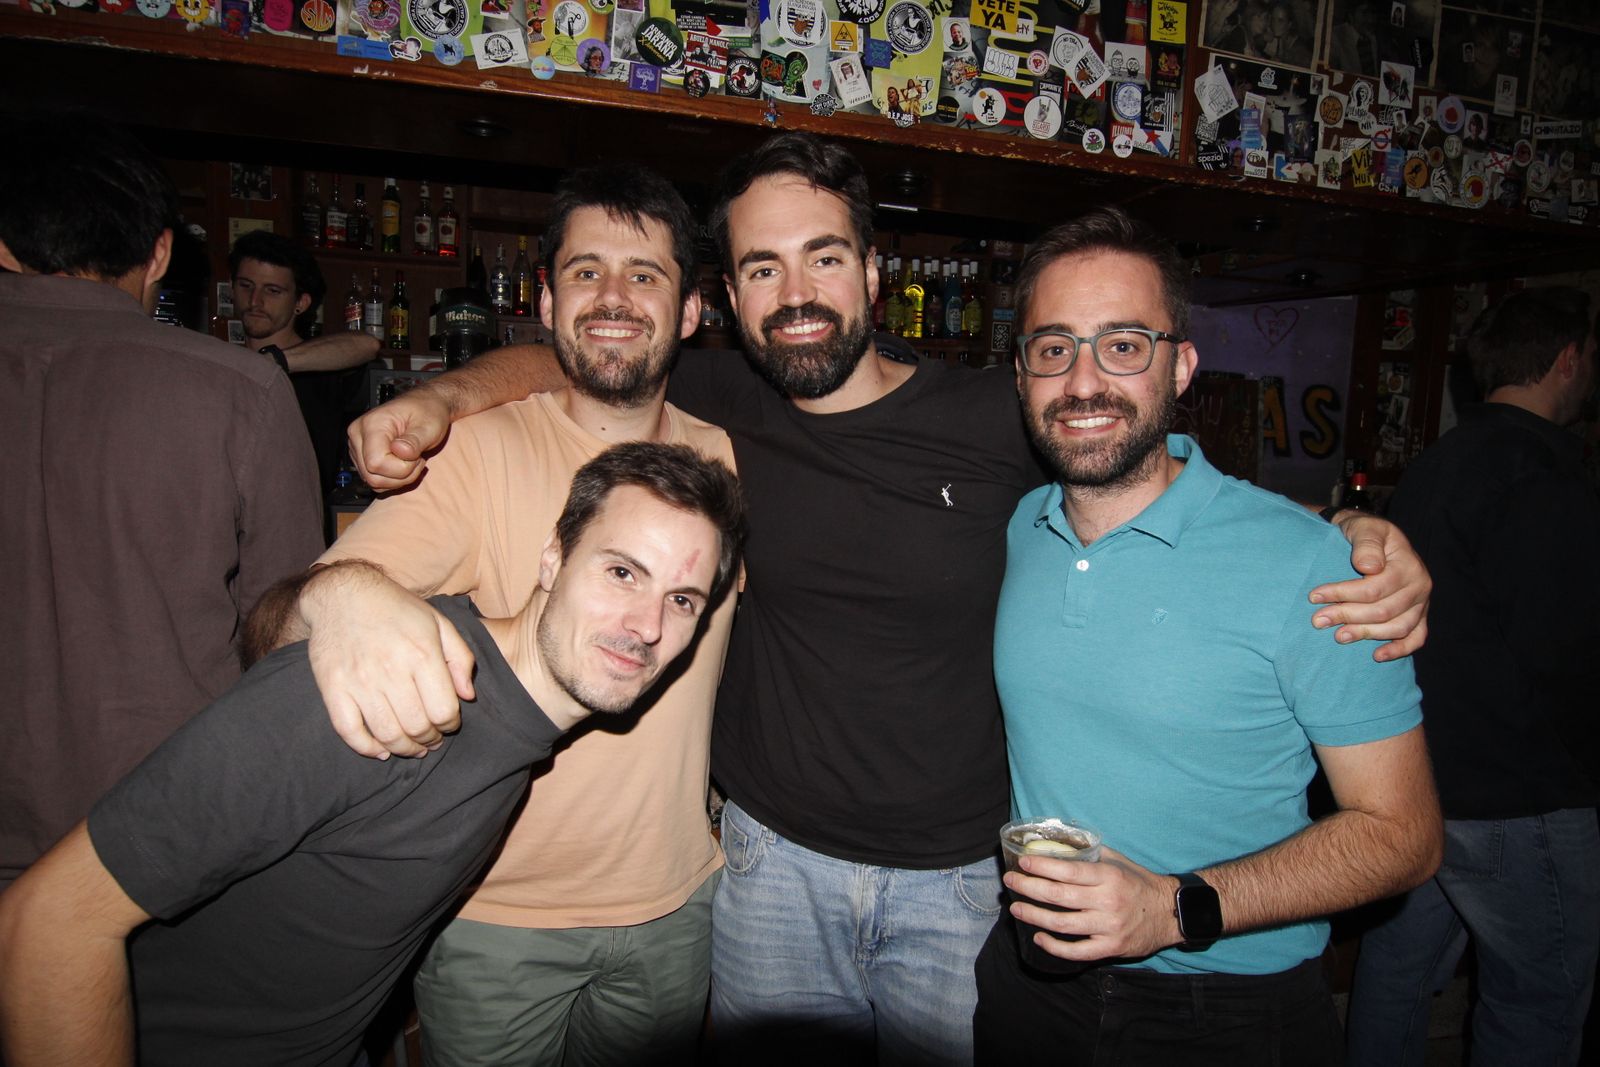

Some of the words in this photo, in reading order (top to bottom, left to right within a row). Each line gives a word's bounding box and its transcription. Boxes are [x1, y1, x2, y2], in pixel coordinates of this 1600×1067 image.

[981, 9, 1006, 31] YA
[641, 29, 675, 60] JARANA
[648, 24, 678, 51] ARMANDO
